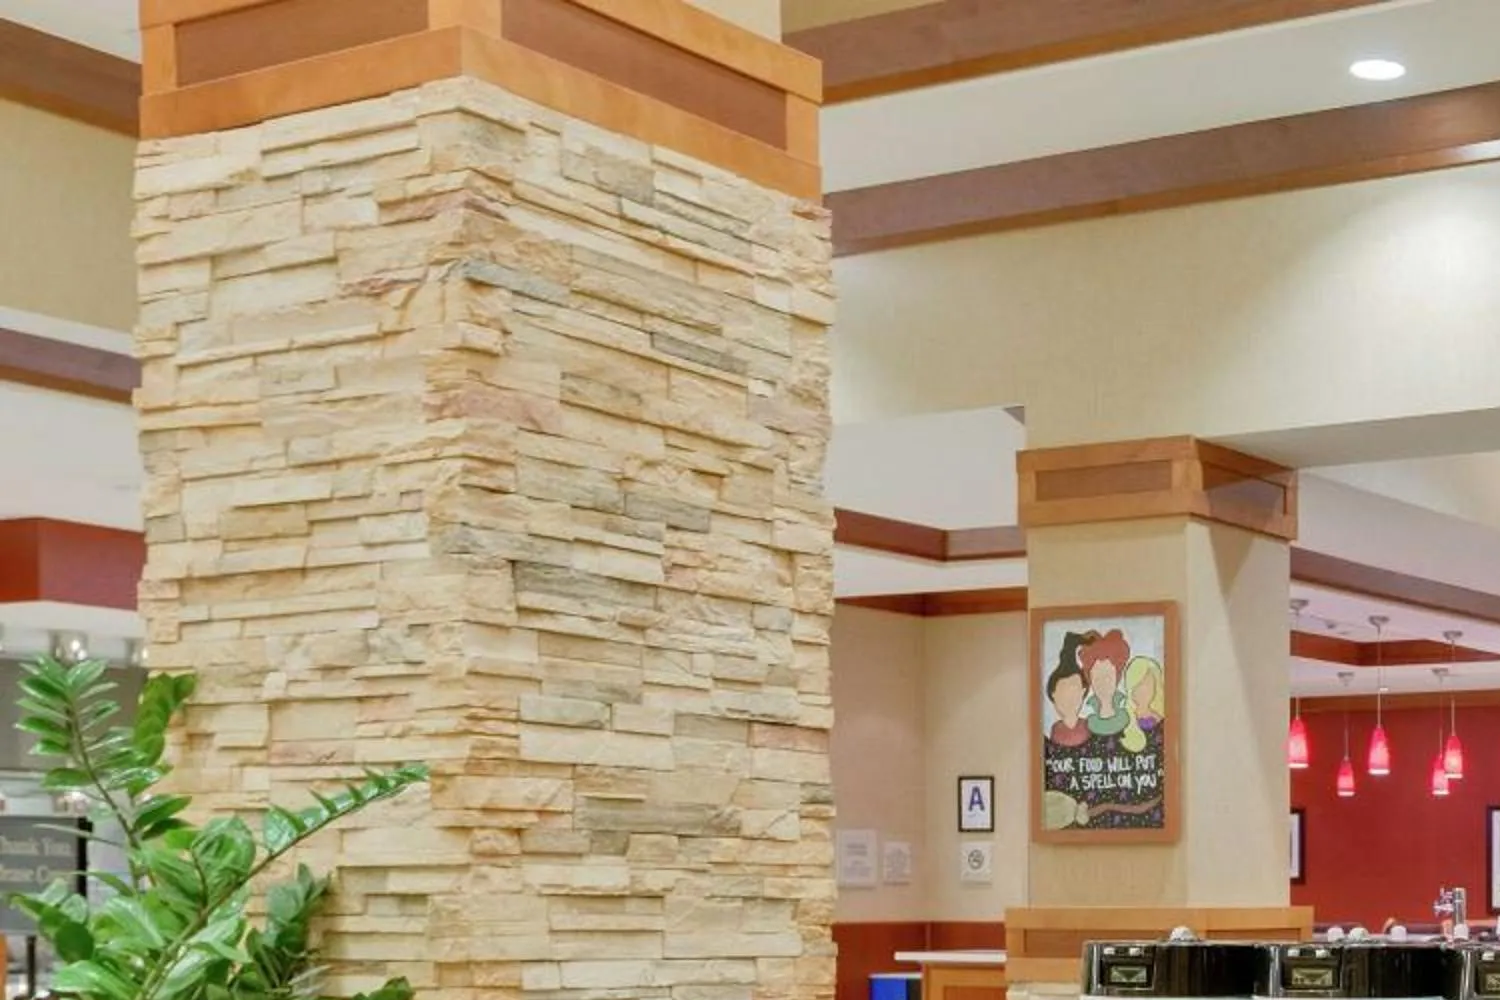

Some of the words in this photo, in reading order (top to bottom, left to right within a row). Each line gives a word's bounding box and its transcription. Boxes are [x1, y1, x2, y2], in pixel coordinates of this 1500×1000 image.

[1107, 756, 1132, 772] WILL
[1135, 754, 1157, 771] PUT
[1069, 776, 1080, 790] A
[1081, 774, 1116, 790] SPELL
[1117, 773, 1133, 789] ON
[968, 785, 986, 812] A
